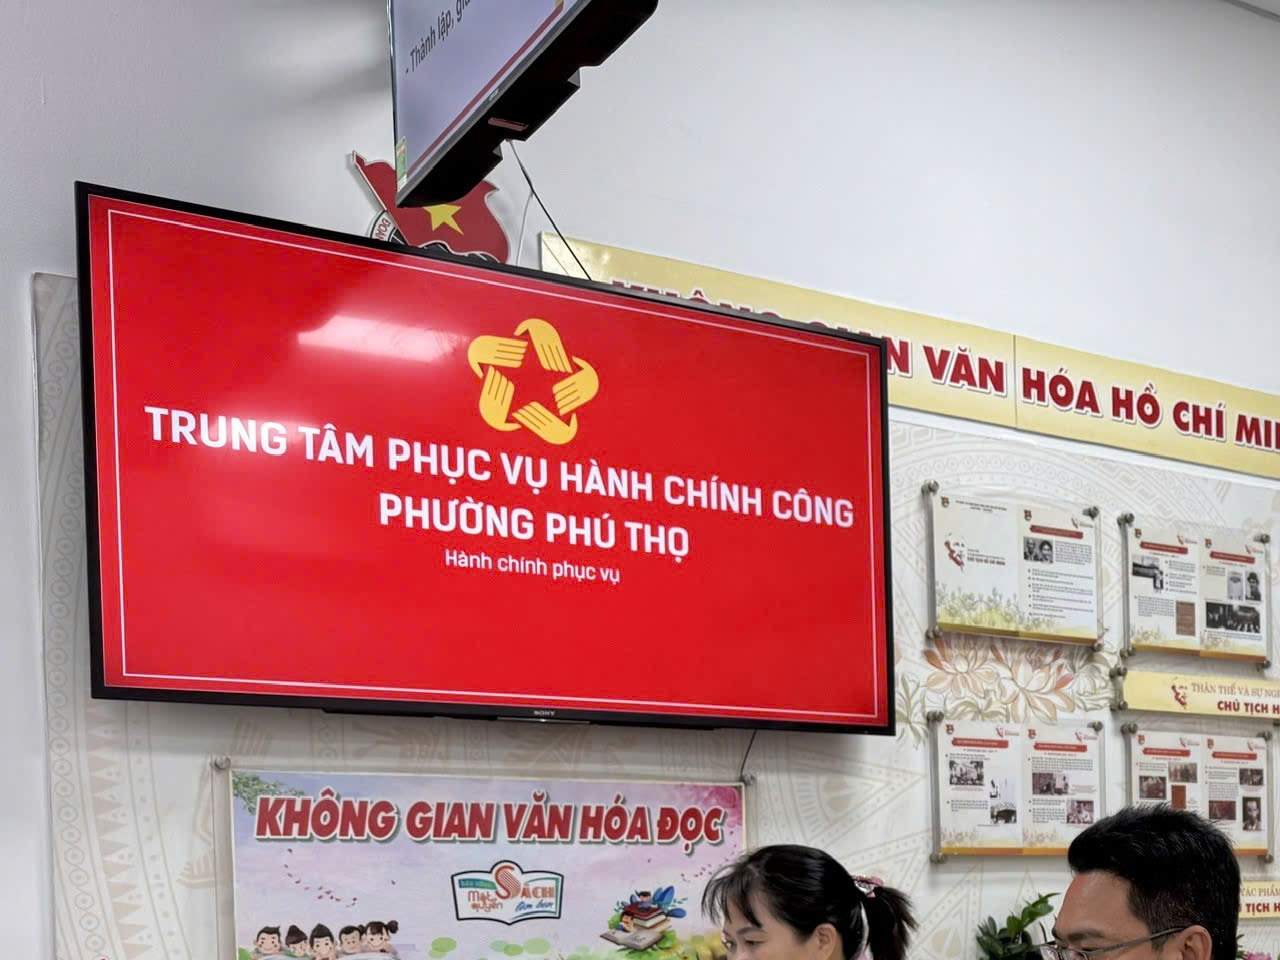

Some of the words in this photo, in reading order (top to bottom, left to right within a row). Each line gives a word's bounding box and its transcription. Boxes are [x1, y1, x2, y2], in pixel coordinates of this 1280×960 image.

[409, 26, 436, 72] Thành
[923, 345, 1005, 394] VĂN
[1022, 367, 1100, 415] HÓA
[1111, 382, 1160, 426] HỒ
[1172, 401, 1224, 439] CHÍ
[145, 405, 287, 456] TRUNG
[298, 423, 374, 467] TÂM
[388, 438, 492, 485] PHỤC
[500, 452, 548, 495] VỤ
[560, 459, 653, 502] HÀNH
[664, 475, 763, 516] CHÍNH
[772, 488, 854, 528] CÔNG
[379, 492, 534, 540] PHƯỜNG
[546, 513, 615, 549] PHÚ
[624, 521, 689, 563] THỌ
[445, 549, 493, 569] Hành
[498, 555, 547, 576] chính
[553, 560, 597, 583] phục
[601, 567, 620, 585] vụ
[1218, 698, 1240, 713] CHỦ
[1244, 701, 1269, 716] TỊCH
[255, 787, 397, 840] KHÔNG
[406, 802, 493, 840] GIAN
[504, 790, 573, 841] VĂN
[579, 794, 648, 842] HÓA
[657, 807, 725, 854] ĐỌC
[1246, 903, 1270, 916] TỊCH
